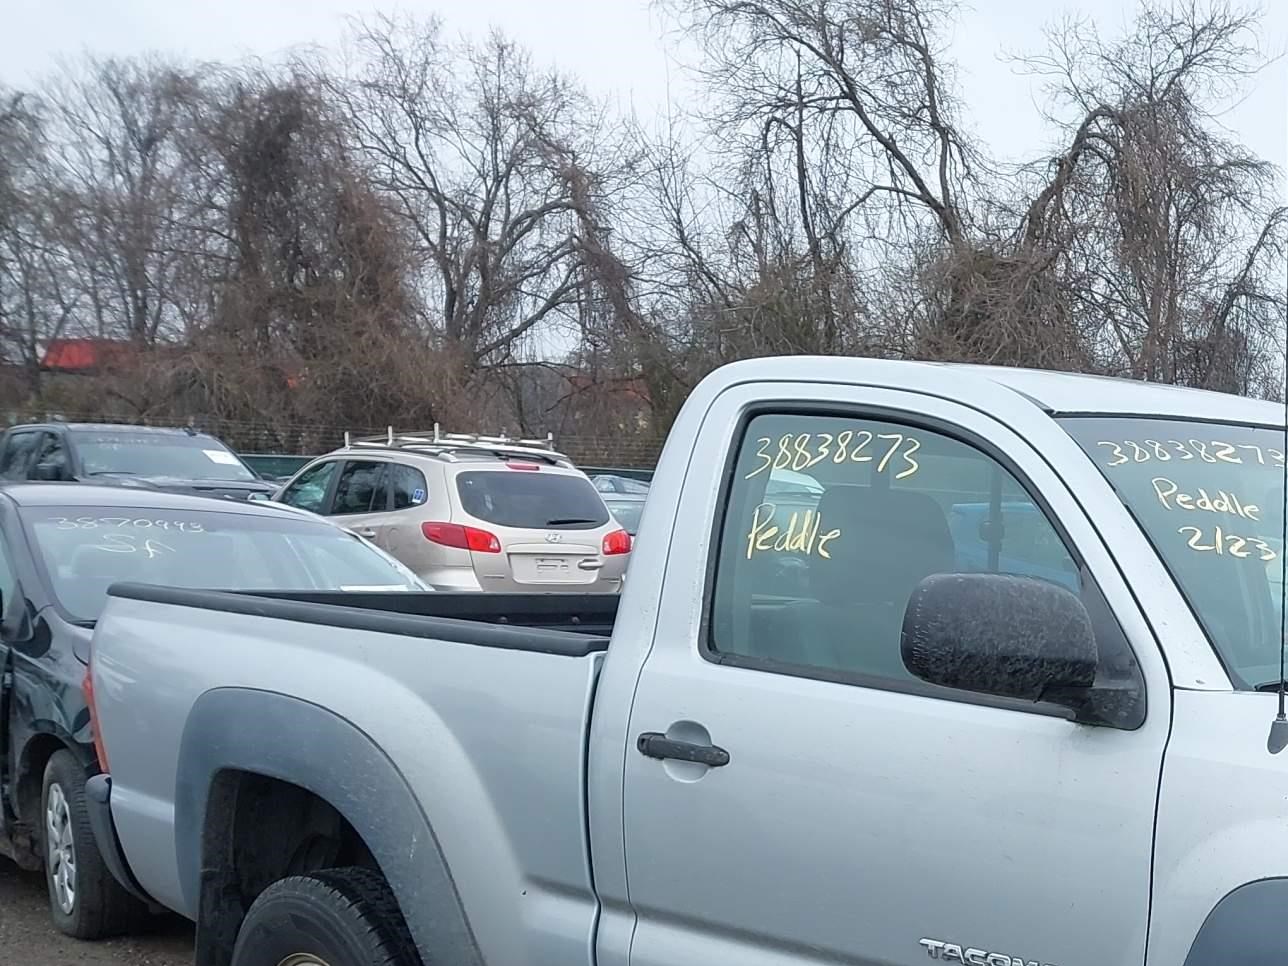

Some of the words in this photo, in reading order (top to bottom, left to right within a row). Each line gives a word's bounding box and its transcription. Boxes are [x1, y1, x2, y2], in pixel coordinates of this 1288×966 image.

[745, 430, 921, 480] 38838273
[1151, 477, 1260, 521] Peddle
[746, 502, 841, 560] Peddle
